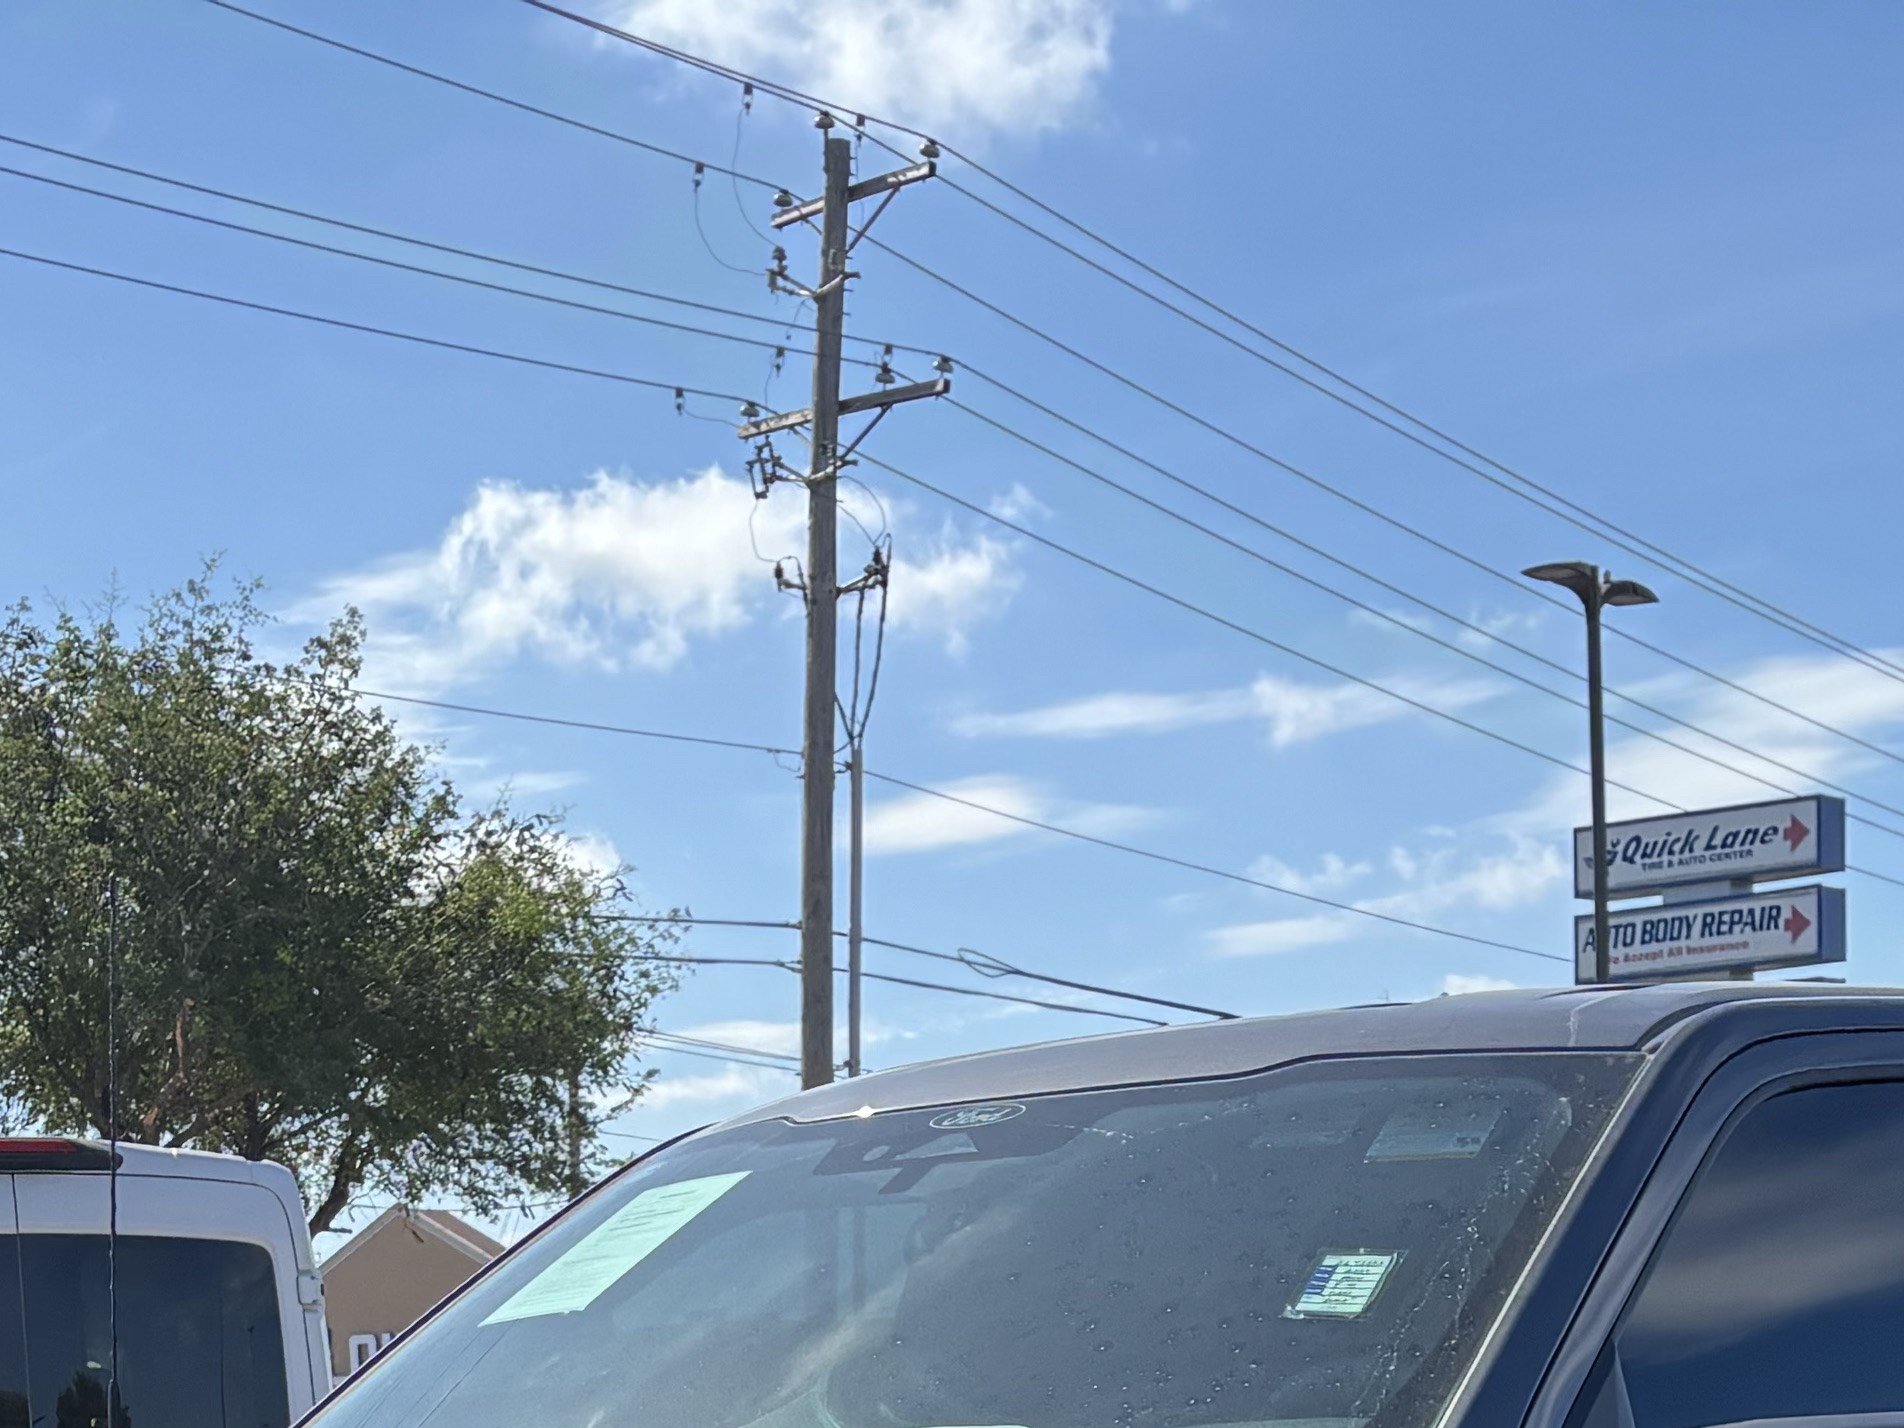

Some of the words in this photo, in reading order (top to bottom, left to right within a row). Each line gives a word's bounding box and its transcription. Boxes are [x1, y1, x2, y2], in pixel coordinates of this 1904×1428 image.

[1621, 829, 1700, 865] Quick
[1703, 825, 1780, 851] Lane
[1641, 860, 1664, 871] TIRE
[1667, 858, 1675, 868] &
[1677, 855, 1705, 867] AUTO
[1708, 849, 1754, 863] CENTER
[1582, 922, 1637, 953] ATO
[1640, 914, 1697, 946] BODY
[1700, 904, 1782, 939] REPAIR
